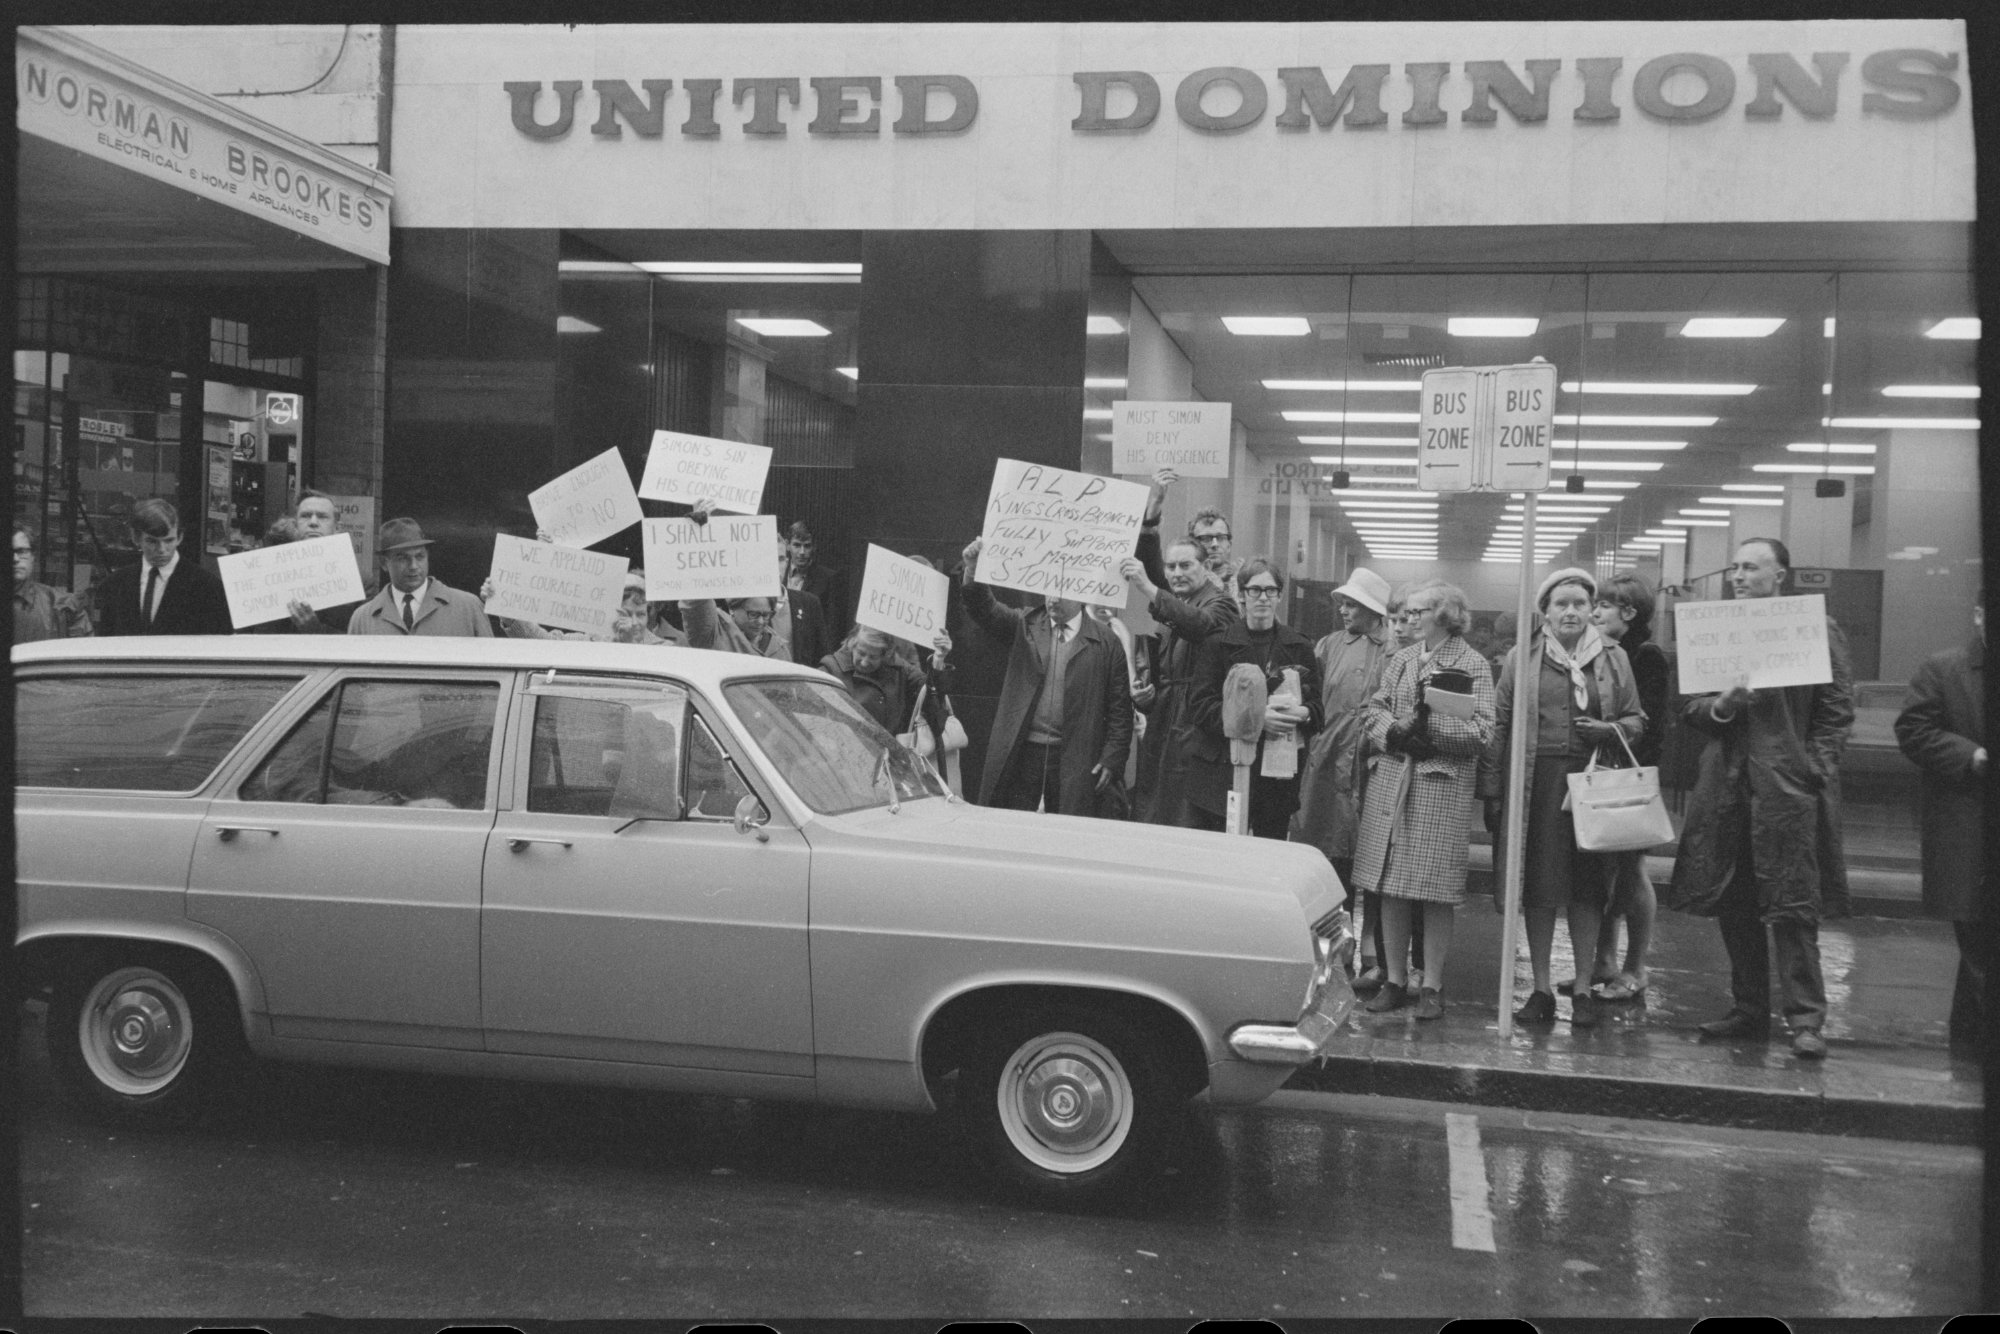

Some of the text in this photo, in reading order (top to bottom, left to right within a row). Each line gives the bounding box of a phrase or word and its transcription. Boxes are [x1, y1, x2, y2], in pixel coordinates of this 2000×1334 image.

[504, 48, 1958, 141] UNITED DOMINIONS
[27, 63, 373, 228] NORMAN BROOKES
[97, 133, 182, 173] ELECTRICAL
[201, 172, 238, 194] HOME
[249, 191, 320, 226] APPLIANCES
[1433, 392, 1467, 415] BUS
[1506, 389, 1542, 412] BUS
[1126, 410, 1201, 425] MUST SIMON
[661, 438, 711, 457] SIMON'S
[1146, 431, 1180, 445] DENY
[1427, 427, 1469, 450] ZONE
[1500, 425, 1545, 448] ZONE
[1126, 449, 1220, 465] HIS CONSCIENCE
[677, 460, 729, 481] OBEYING
[655, 477, 759, 506] HIS CONSCIENCE
[566, 502, 583, 518] TO
[592, 497, 616, 526] NO
[989, 492, 1045, 516] KINGS
[1080, 505, 1140, 528] BRANCH
[651, 522, 762, 545] I SHALL NOT
[243, 545, 323, 569] WE APPLAUD
[520, 544, 605, 576] WE APPLAUD
[1043, 550, 1112, 571] MEMBER
[232, 560, 338, 592] THE COURAGE OF
[498, 568, 607, 601] THE COURAGE OF
[692, 576, 743, 589] TOWNSEND
[888, 562, 926, 598] SIMON
[1018, 563, 1120, 597] TOWNSEND
[242, 577, 348, 614] SIMON TOWNSEND
[500, 590, 606, 627] SIMON TOWNSEND
[869, 589, 933, 631] REFUSES
[1687, 625, 1820, 646] WHEN ALL YOUNG MEN
[1695, 656, 1744, 674] REFUSE
